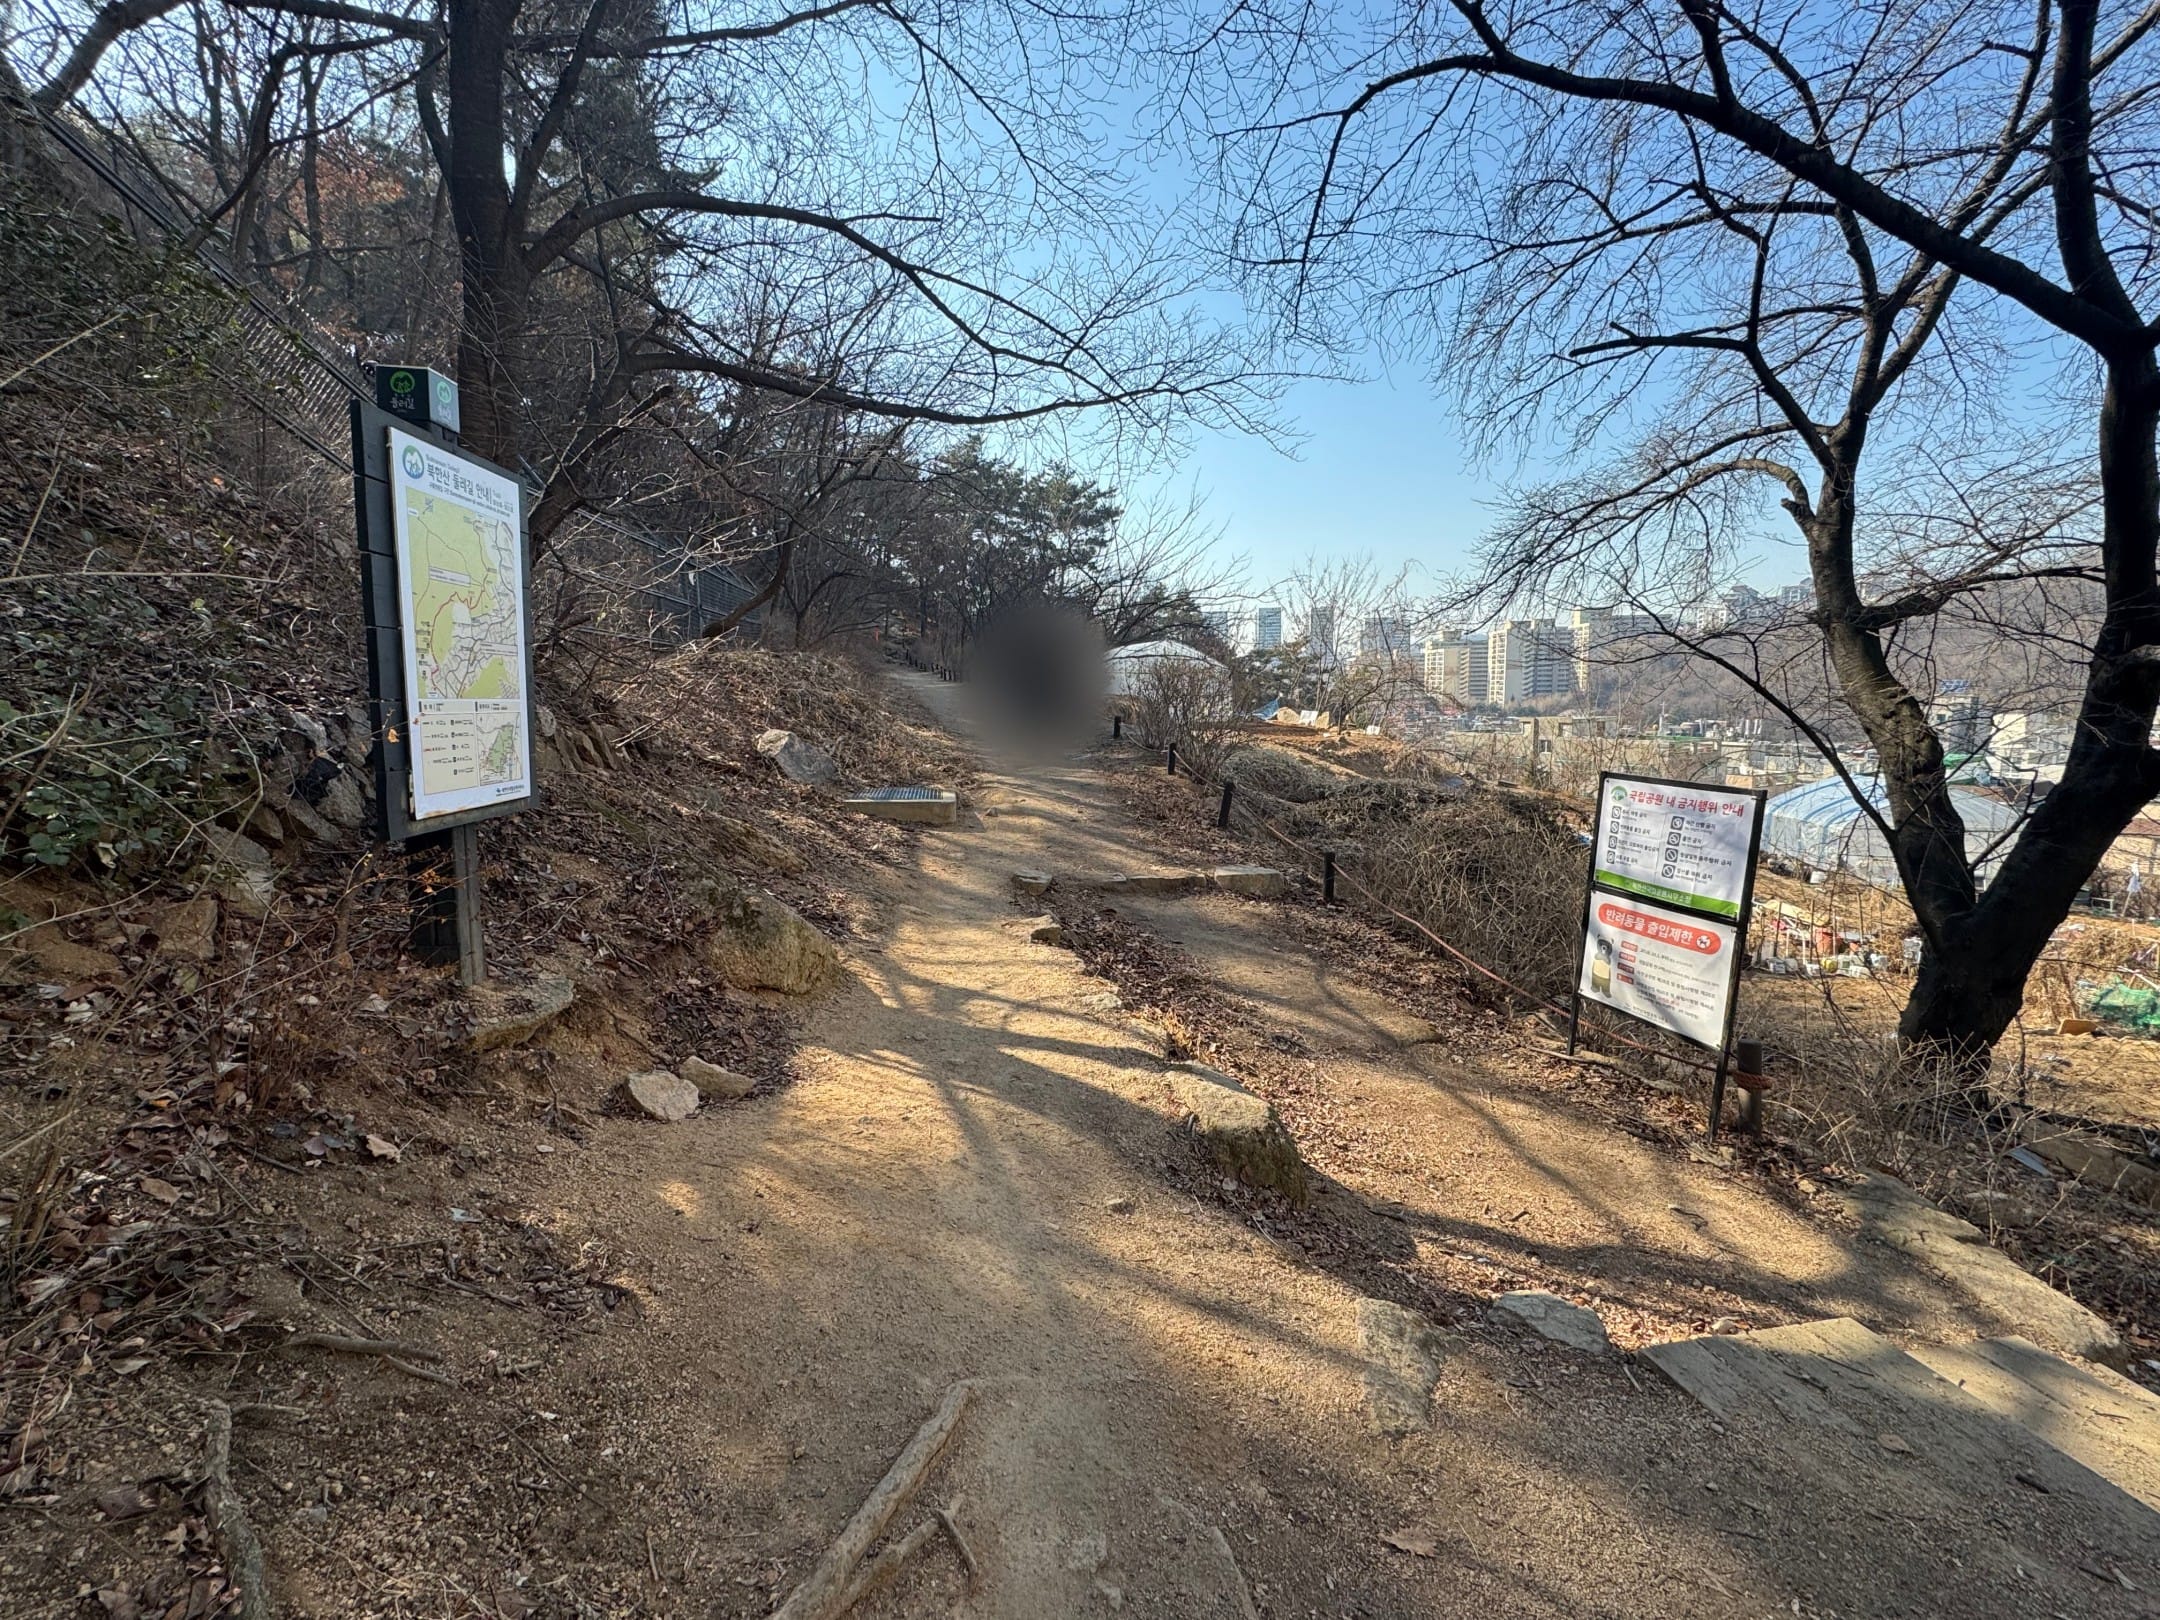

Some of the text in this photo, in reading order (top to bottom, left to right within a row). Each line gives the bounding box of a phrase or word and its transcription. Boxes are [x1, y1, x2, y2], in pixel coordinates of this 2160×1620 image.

[427, 463, 450, 487] 북한산
[452, 473, 474, 496] 둘레길
[476, 483, 490, 502] 안내
[1629, 789, 1745, 817] 국립공원 내 금지행위 안내
[1606, 908, 1694, 944] 반려동물 출입제한
